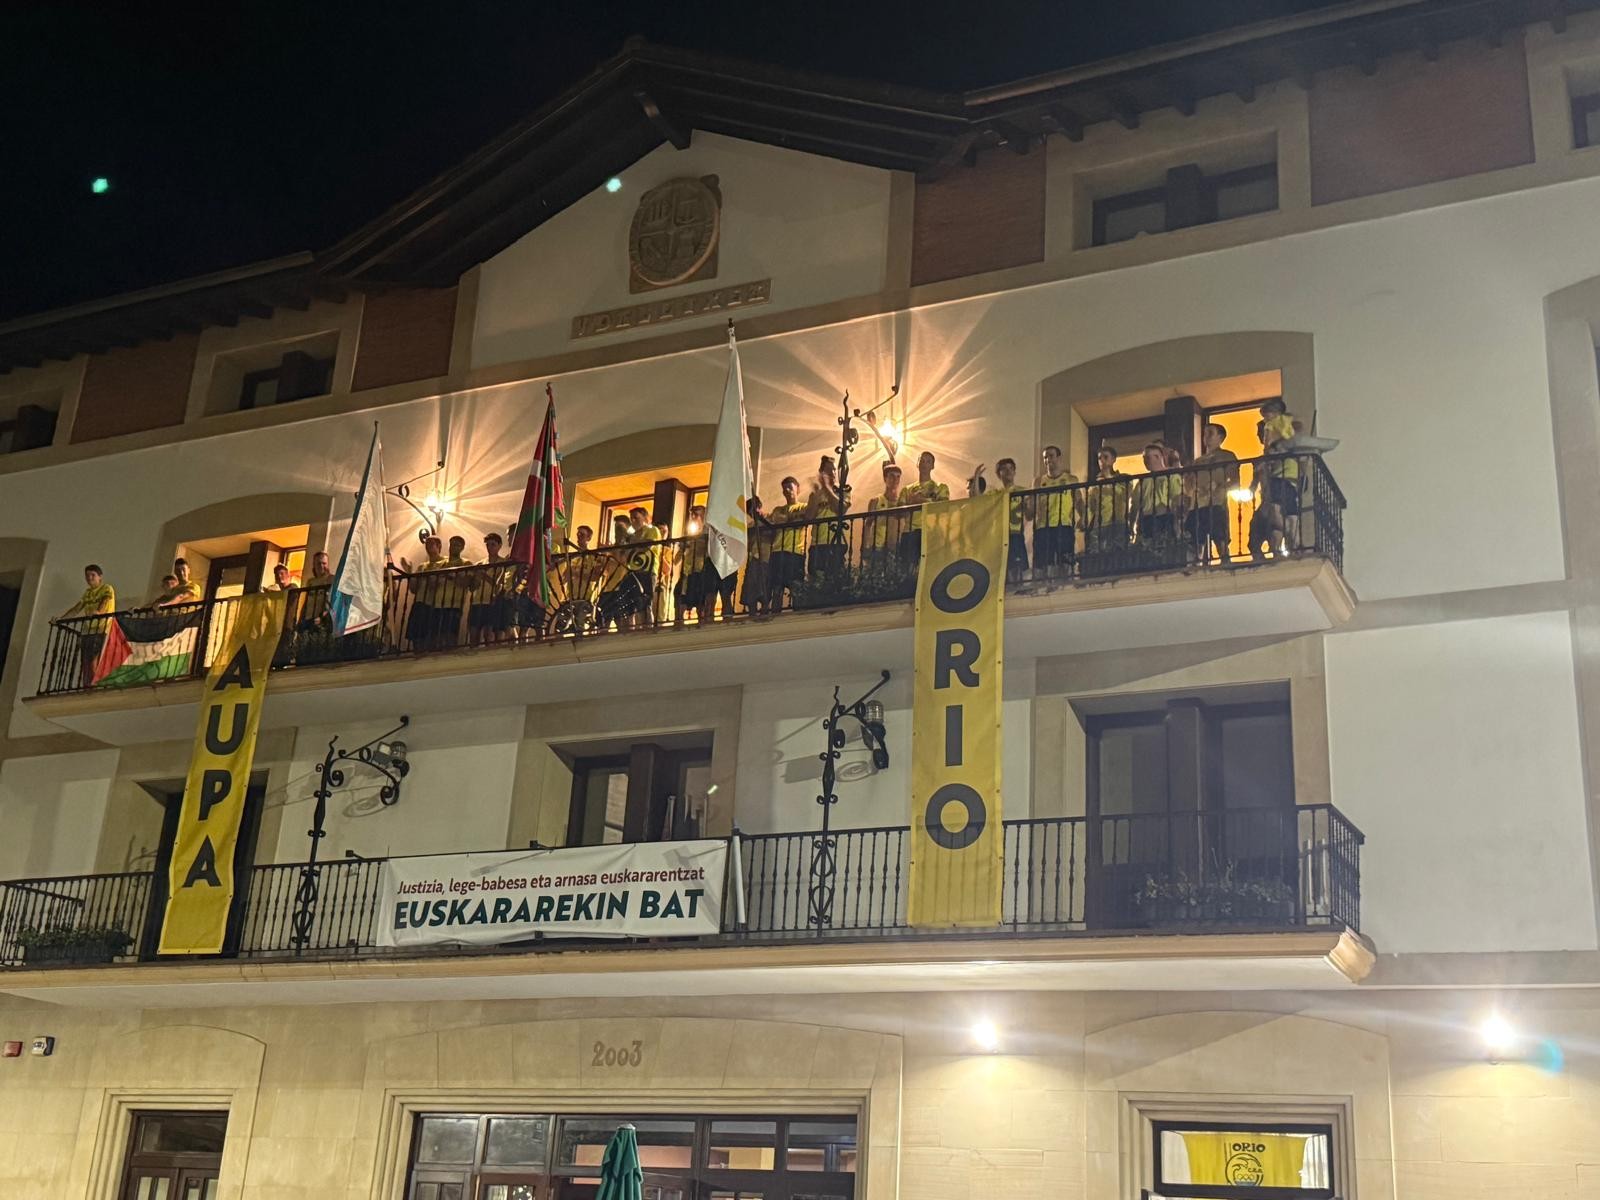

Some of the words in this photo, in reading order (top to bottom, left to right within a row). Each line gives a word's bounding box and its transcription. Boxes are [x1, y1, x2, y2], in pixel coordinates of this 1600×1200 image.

[924, 559, 991, 850] ORIO
[182, 643, 254, 888] AUPA
[397, 879, 445, 896] Justizia,
[449, 876, 527, 895] lege-babesa
[530, 875, 551, 889] eta
[554, 873, 597, 888] arnasa
[600, 867, 705, 885] euskararentzat
[394, 890, 630, 930] EUSKARAREKIN
[639, 889, 705, 919] BAT
[591, 1040, 643, 1067] 2003
